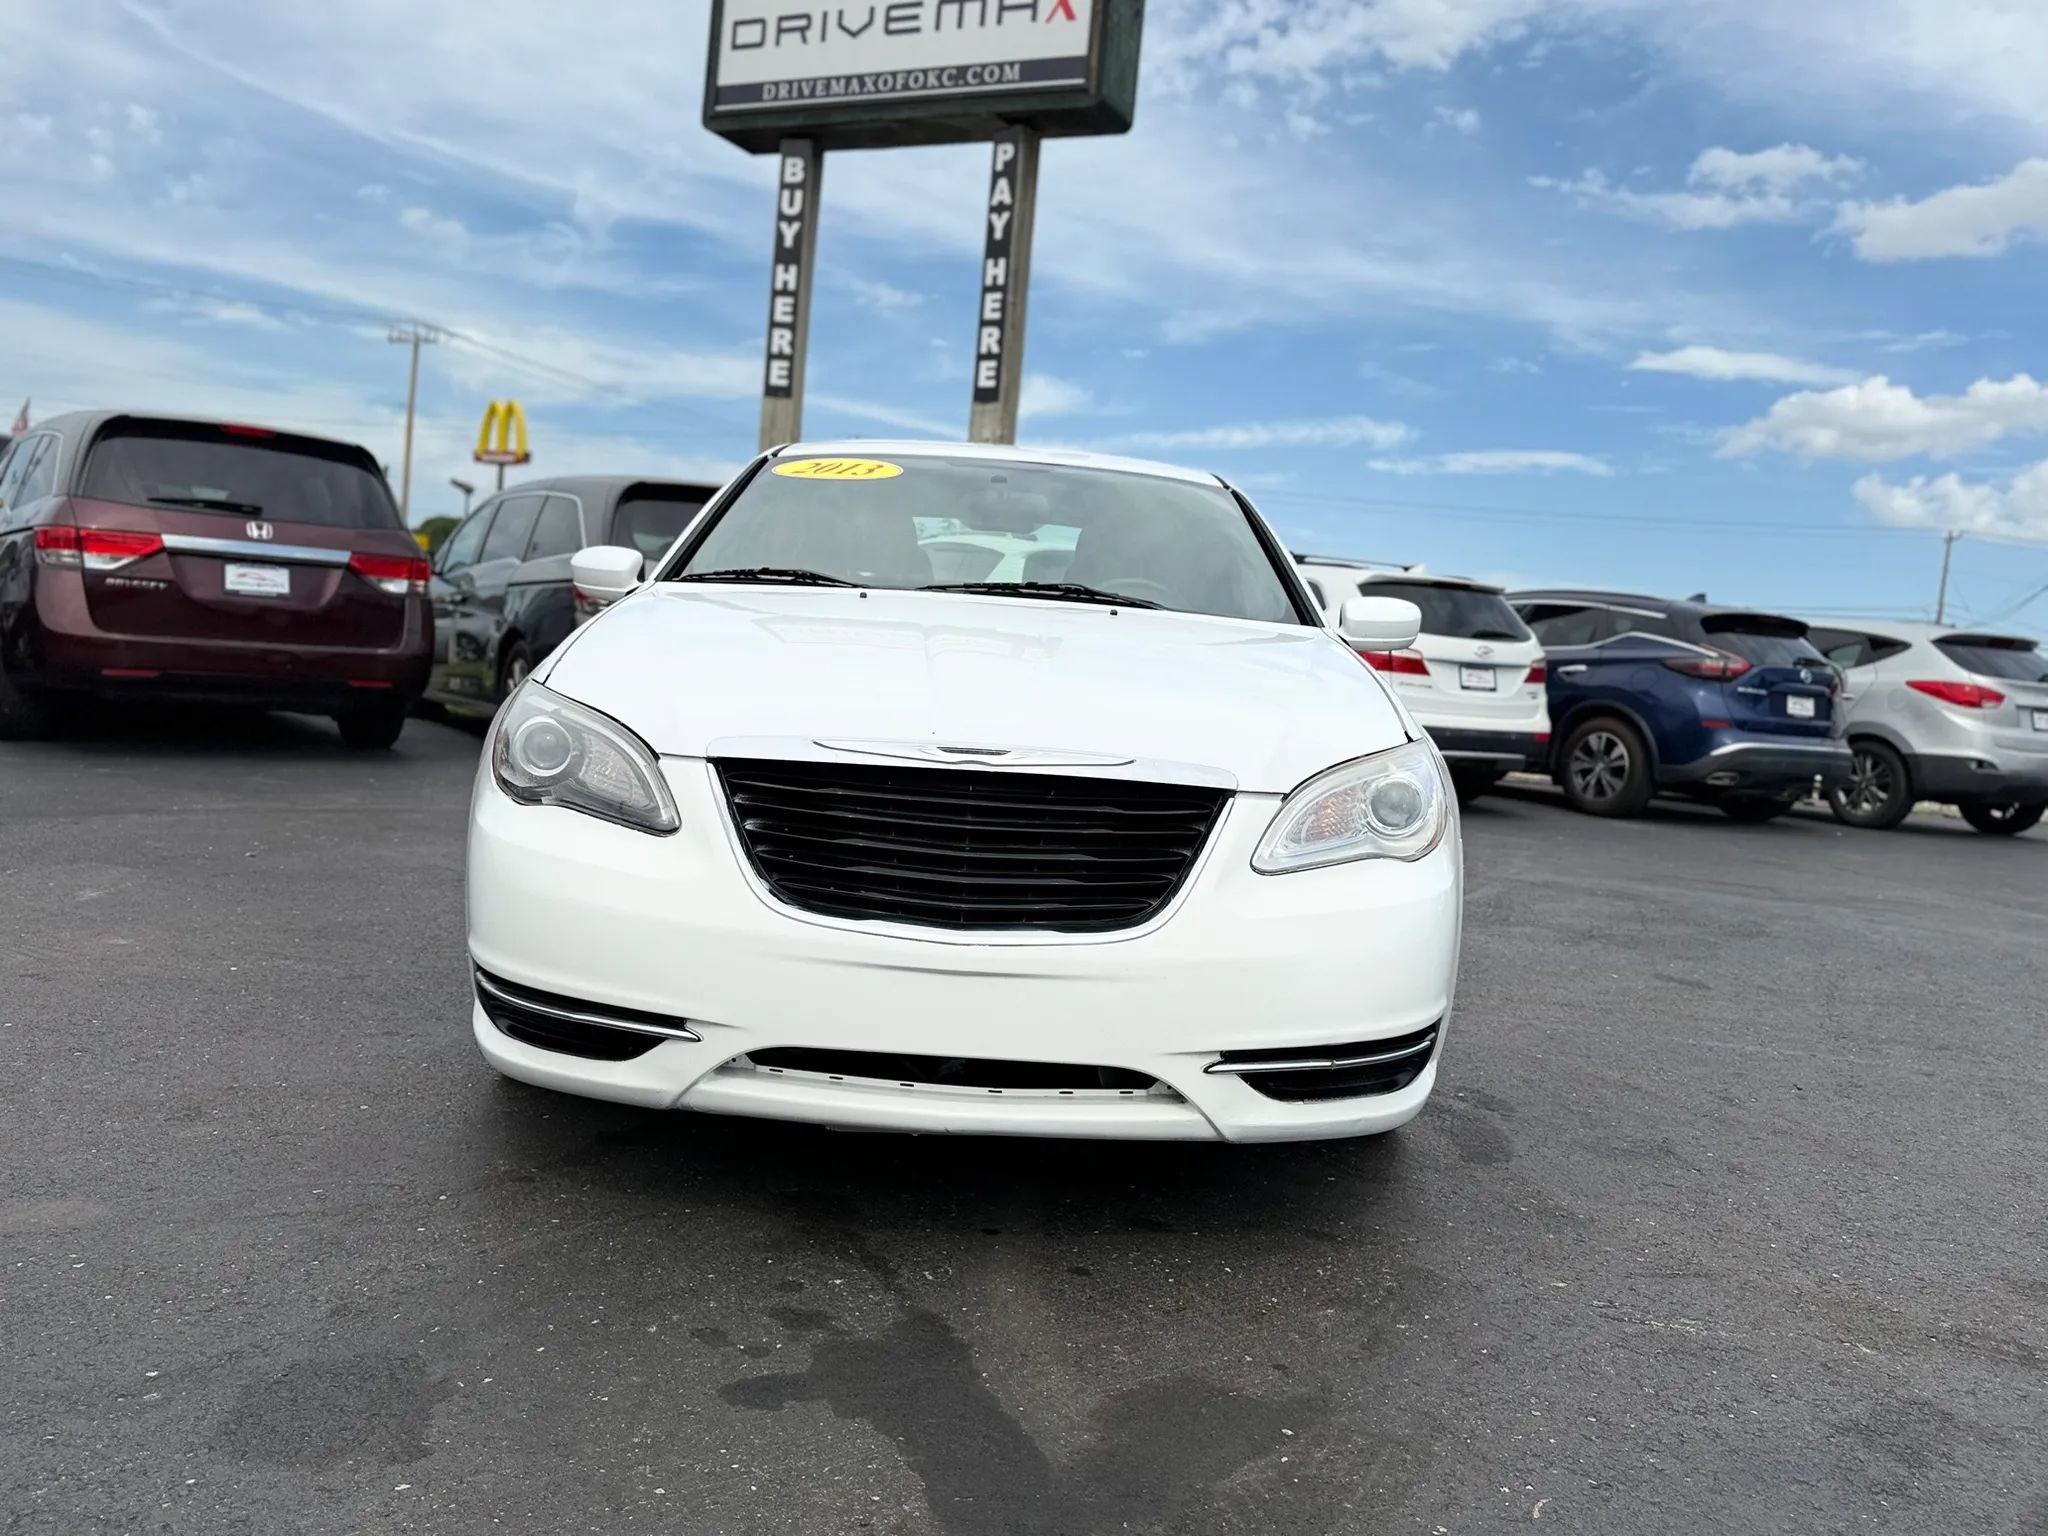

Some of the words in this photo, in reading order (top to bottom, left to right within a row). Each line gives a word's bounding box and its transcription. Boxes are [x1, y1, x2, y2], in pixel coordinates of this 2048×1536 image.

[762, 63, 1020, 100] DRIVEMAXOFOKC.COM
[779, 156, 805, 248] BUY
[989, 143, 1015, 240] PAY
[768, 263, 798, 387] HERE
[977, 257, 1006, 388] HERE
[791, 462, 884, 475] 2013
